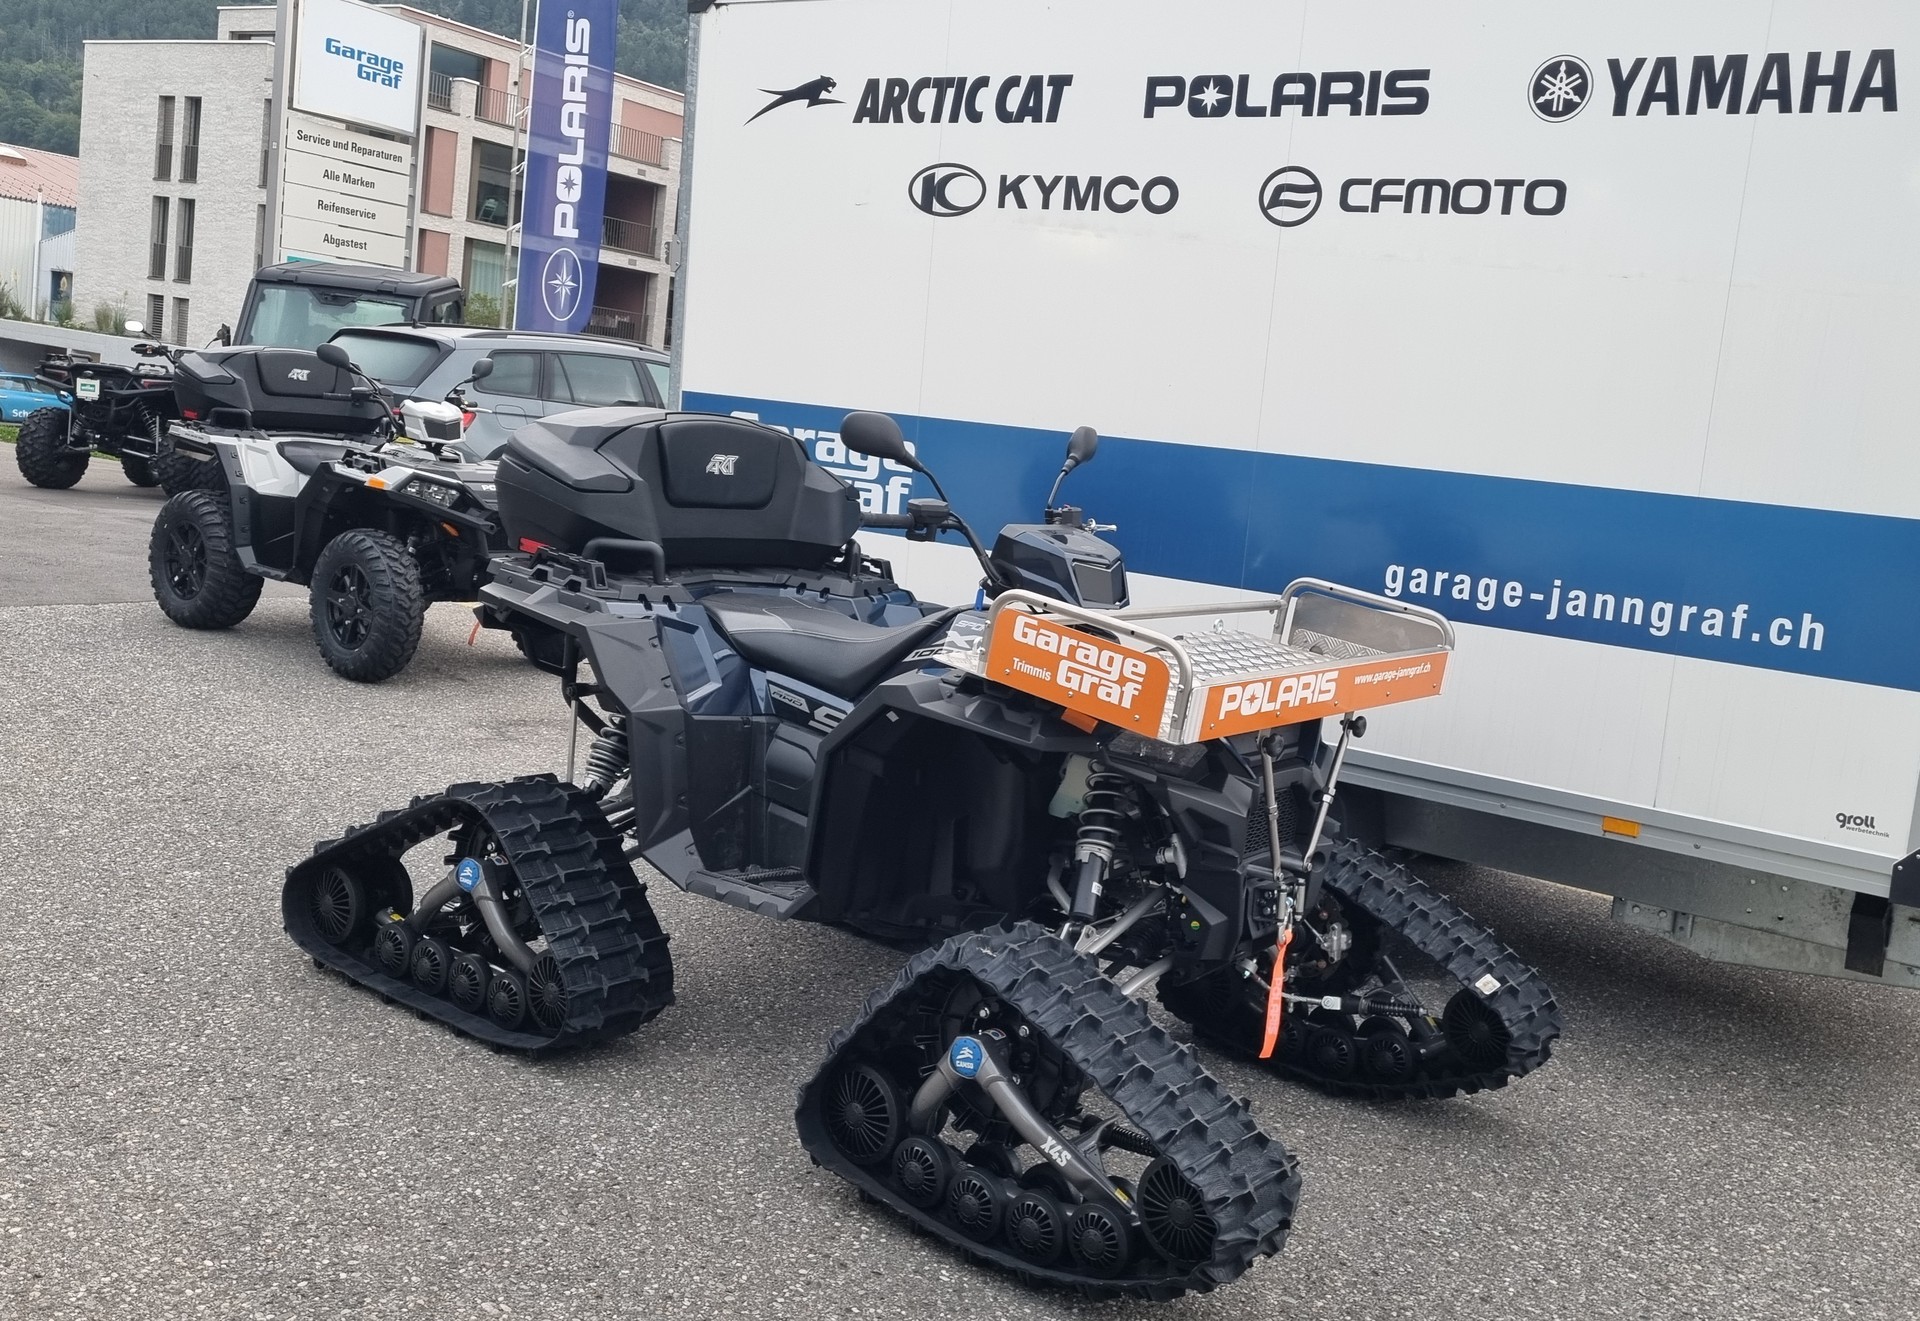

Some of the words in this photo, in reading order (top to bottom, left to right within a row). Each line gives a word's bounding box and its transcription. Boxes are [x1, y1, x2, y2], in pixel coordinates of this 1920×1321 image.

[325, 37, 404, 75] Garage
[357, 63, 403, 90] Graf
[1143, 68, 1431, 119] POLARIS
[1606, 49, 1898, 117] YAMAHA
[852, 75, 991, 123] ARCTIC
[995, 74, 1074, 123] CAT
[297, 129, 331, 147] Service
[333, 140, 349, 151] und
[351, 142, 403, 163] Reparaturen
[553, 17, 590, 238] POLARIS
[322, 169, 340, 182] Alle
[342, 173, 376, 189] Marken
[997, 174, 1180, 215] KYMCO
[1338, 177, 1568, 216] CFMOTO
[317, 199, 377, 220] Reifenservice
[322, 233, 368, 251] Abgastest
[1384, 563, 1825, 651] garage-janngraf.ch
[1013, 615, 1147, 682] Garage
[1012, 657, 1052, 681] Trimmis
[1056, 659, 1142, 709] Graf
[1354, 662, 1432, 686] www.garage-janngraf.ch
[1218, 670, 1339, 721] POLARIS
[1835, 812, 1876, 829] groll
[1845, 825, 1890, 838] werbetechnik
[1040, 1135, 1072, 1167] X4S
